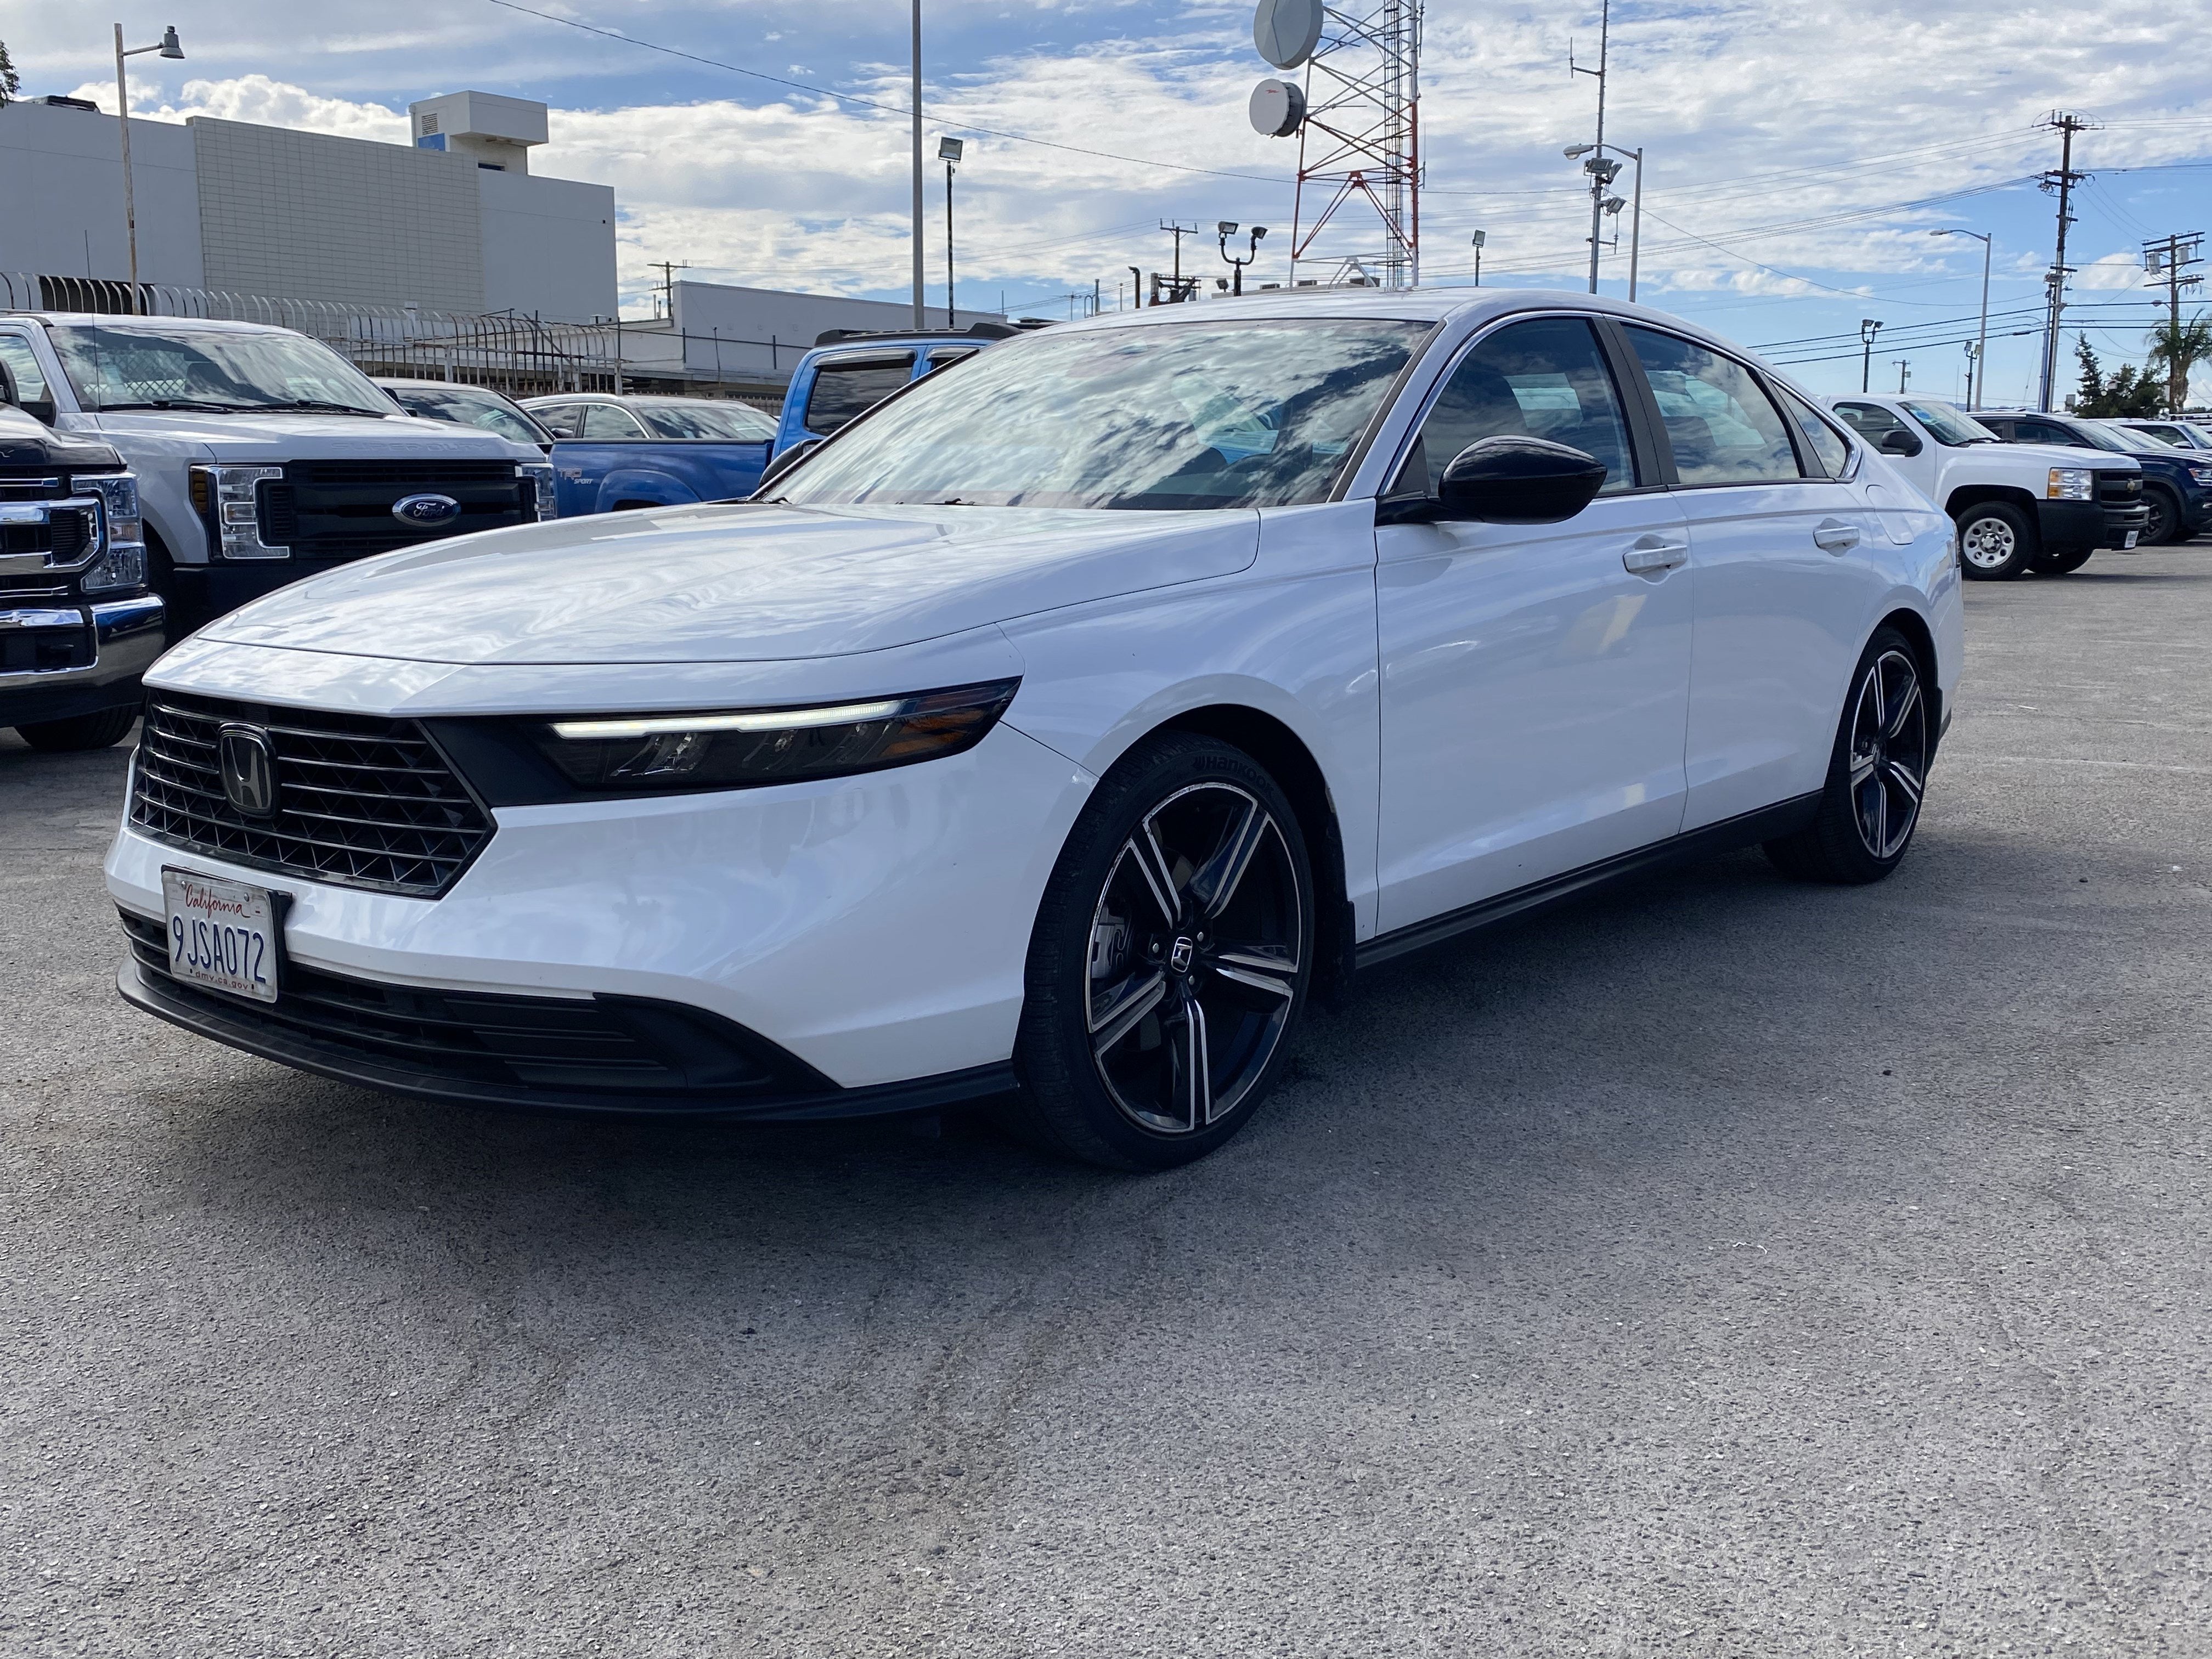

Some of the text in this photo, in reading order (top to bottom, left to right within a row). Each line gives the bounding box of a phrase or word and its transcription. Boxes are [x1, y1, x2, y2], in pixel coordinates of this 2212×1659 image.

[330, 442, 487, 452] SUPER DUTY
[557, 468, 582, 481] TRD
[413, 502, 445, 517] Ford
[185, 884, 251, 919] California
[172, 915, 266, 984] 9JSA072
[195, 970, 249, 990] dmv.ca.gov
